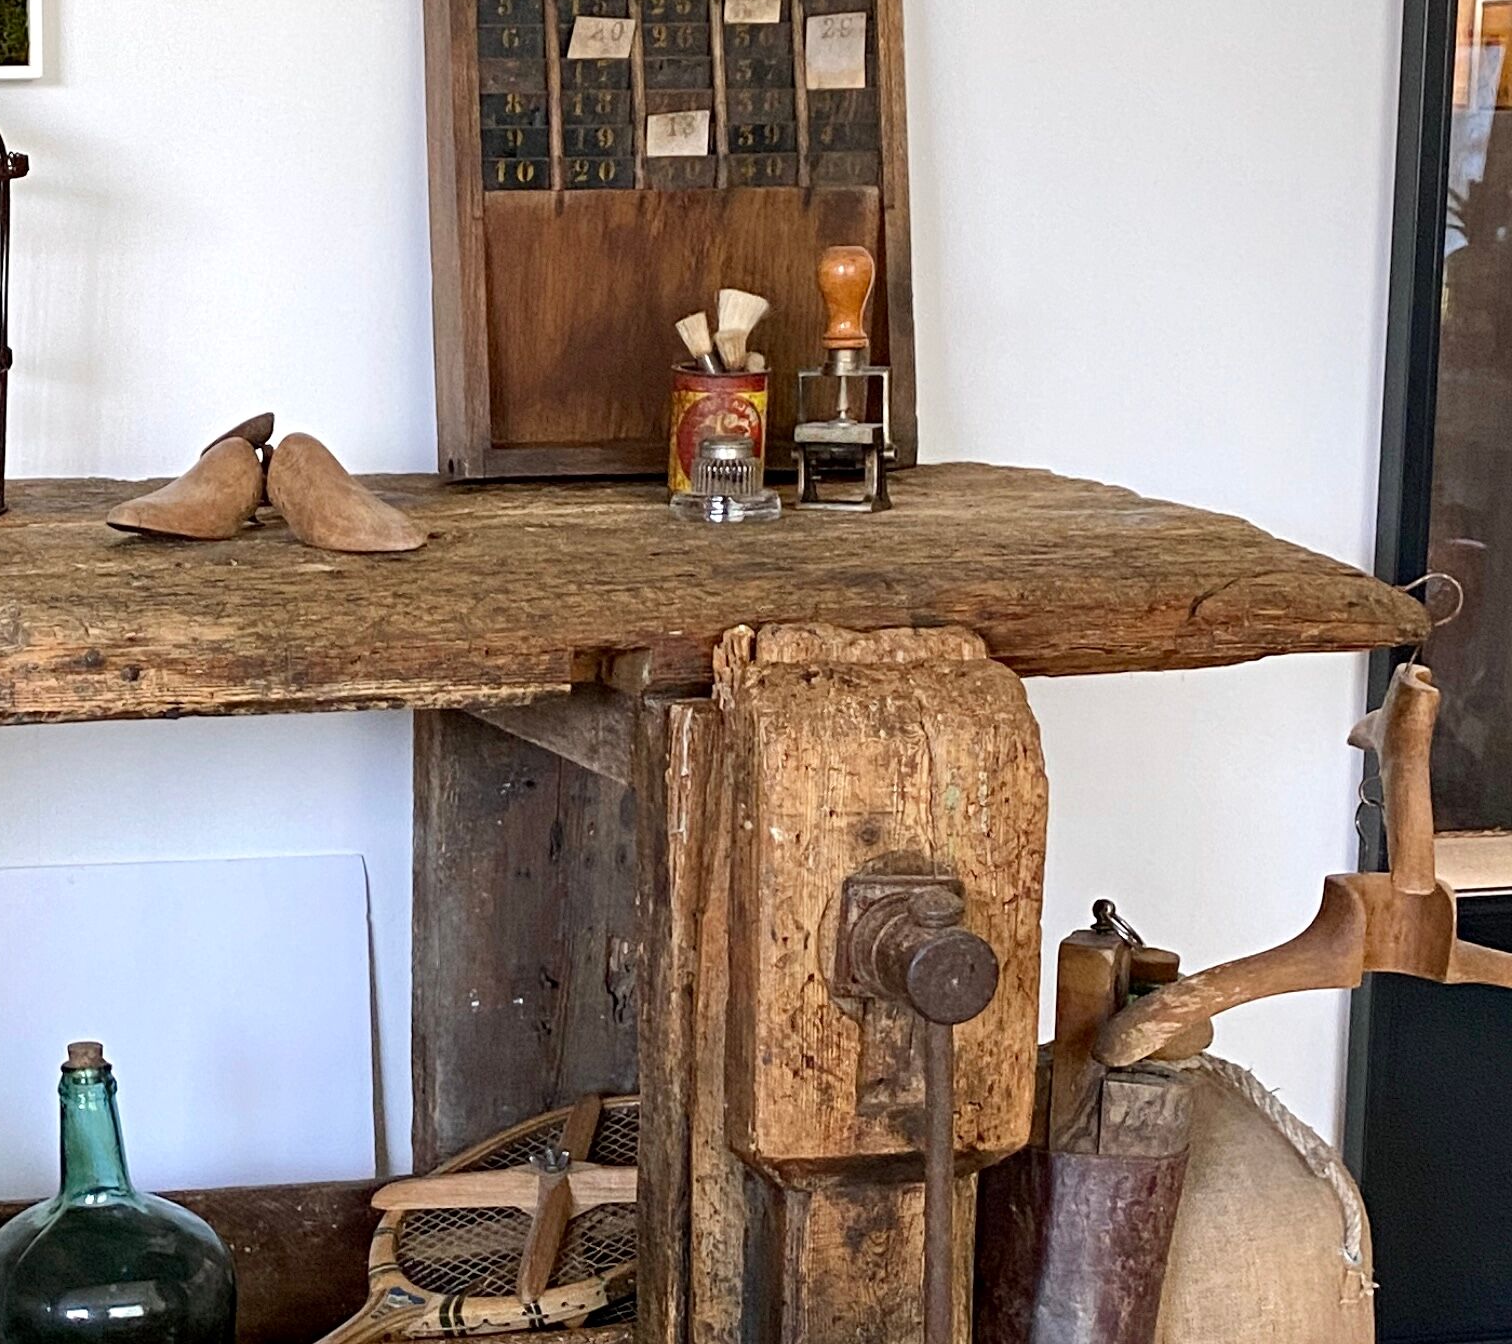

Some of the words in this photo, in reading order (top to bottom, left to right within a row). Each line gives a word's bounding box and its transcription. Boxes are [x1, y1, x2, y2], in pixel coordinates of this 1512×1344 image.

[502, 27, 521, 49] 6
[652, 25, 694, 49] 26
[505, 93, 523, 116] 8
[573, 93, 614, 117] 18
[506, 127, 525, 148] 9
[576, 125, 614, 150] 19
[495, 160, 535, 185] 10
[572, 159, 616, 183] 20
